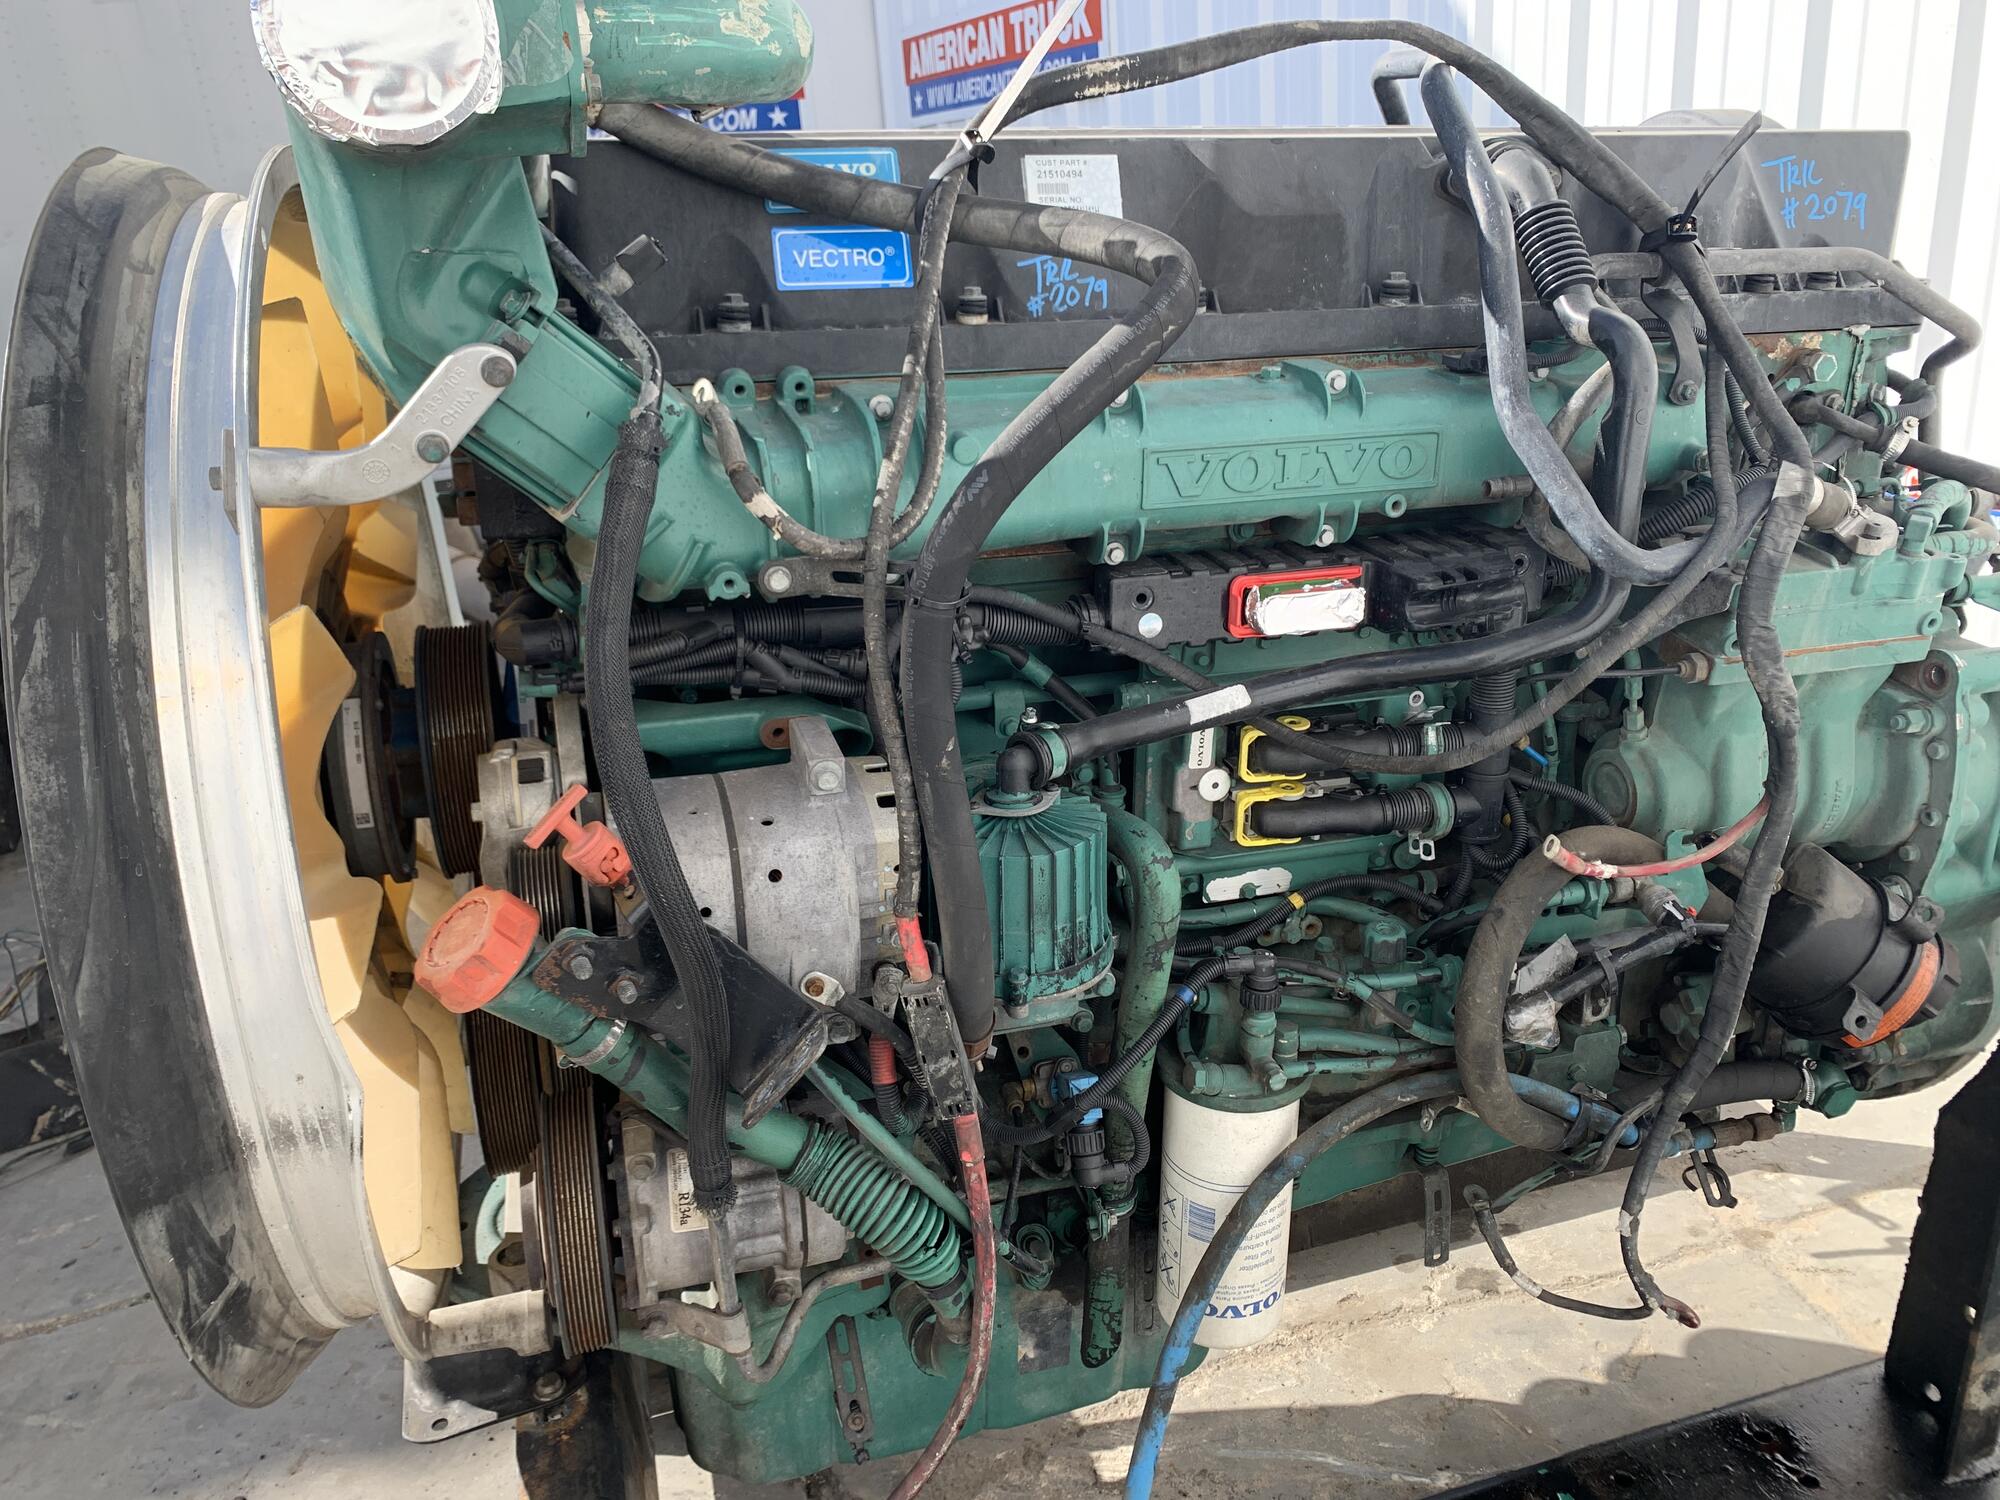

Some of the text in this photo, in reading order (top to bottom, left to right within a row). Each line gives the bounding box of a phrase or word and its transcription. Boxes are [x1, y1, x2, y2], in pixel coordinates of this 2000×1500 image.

[909, 15, 1006, 80] AMERICAN
[1036, 170, 1083, 179] 21510494
[1780, 190, 1868, 230] #2079
[440, 386, 480, 427] CHINA
[1157, 439, 1428, 497] VOLVO
[1197, 728, 1206, 767] VOLVO
[678, 1191, 692, 1226] R134a
